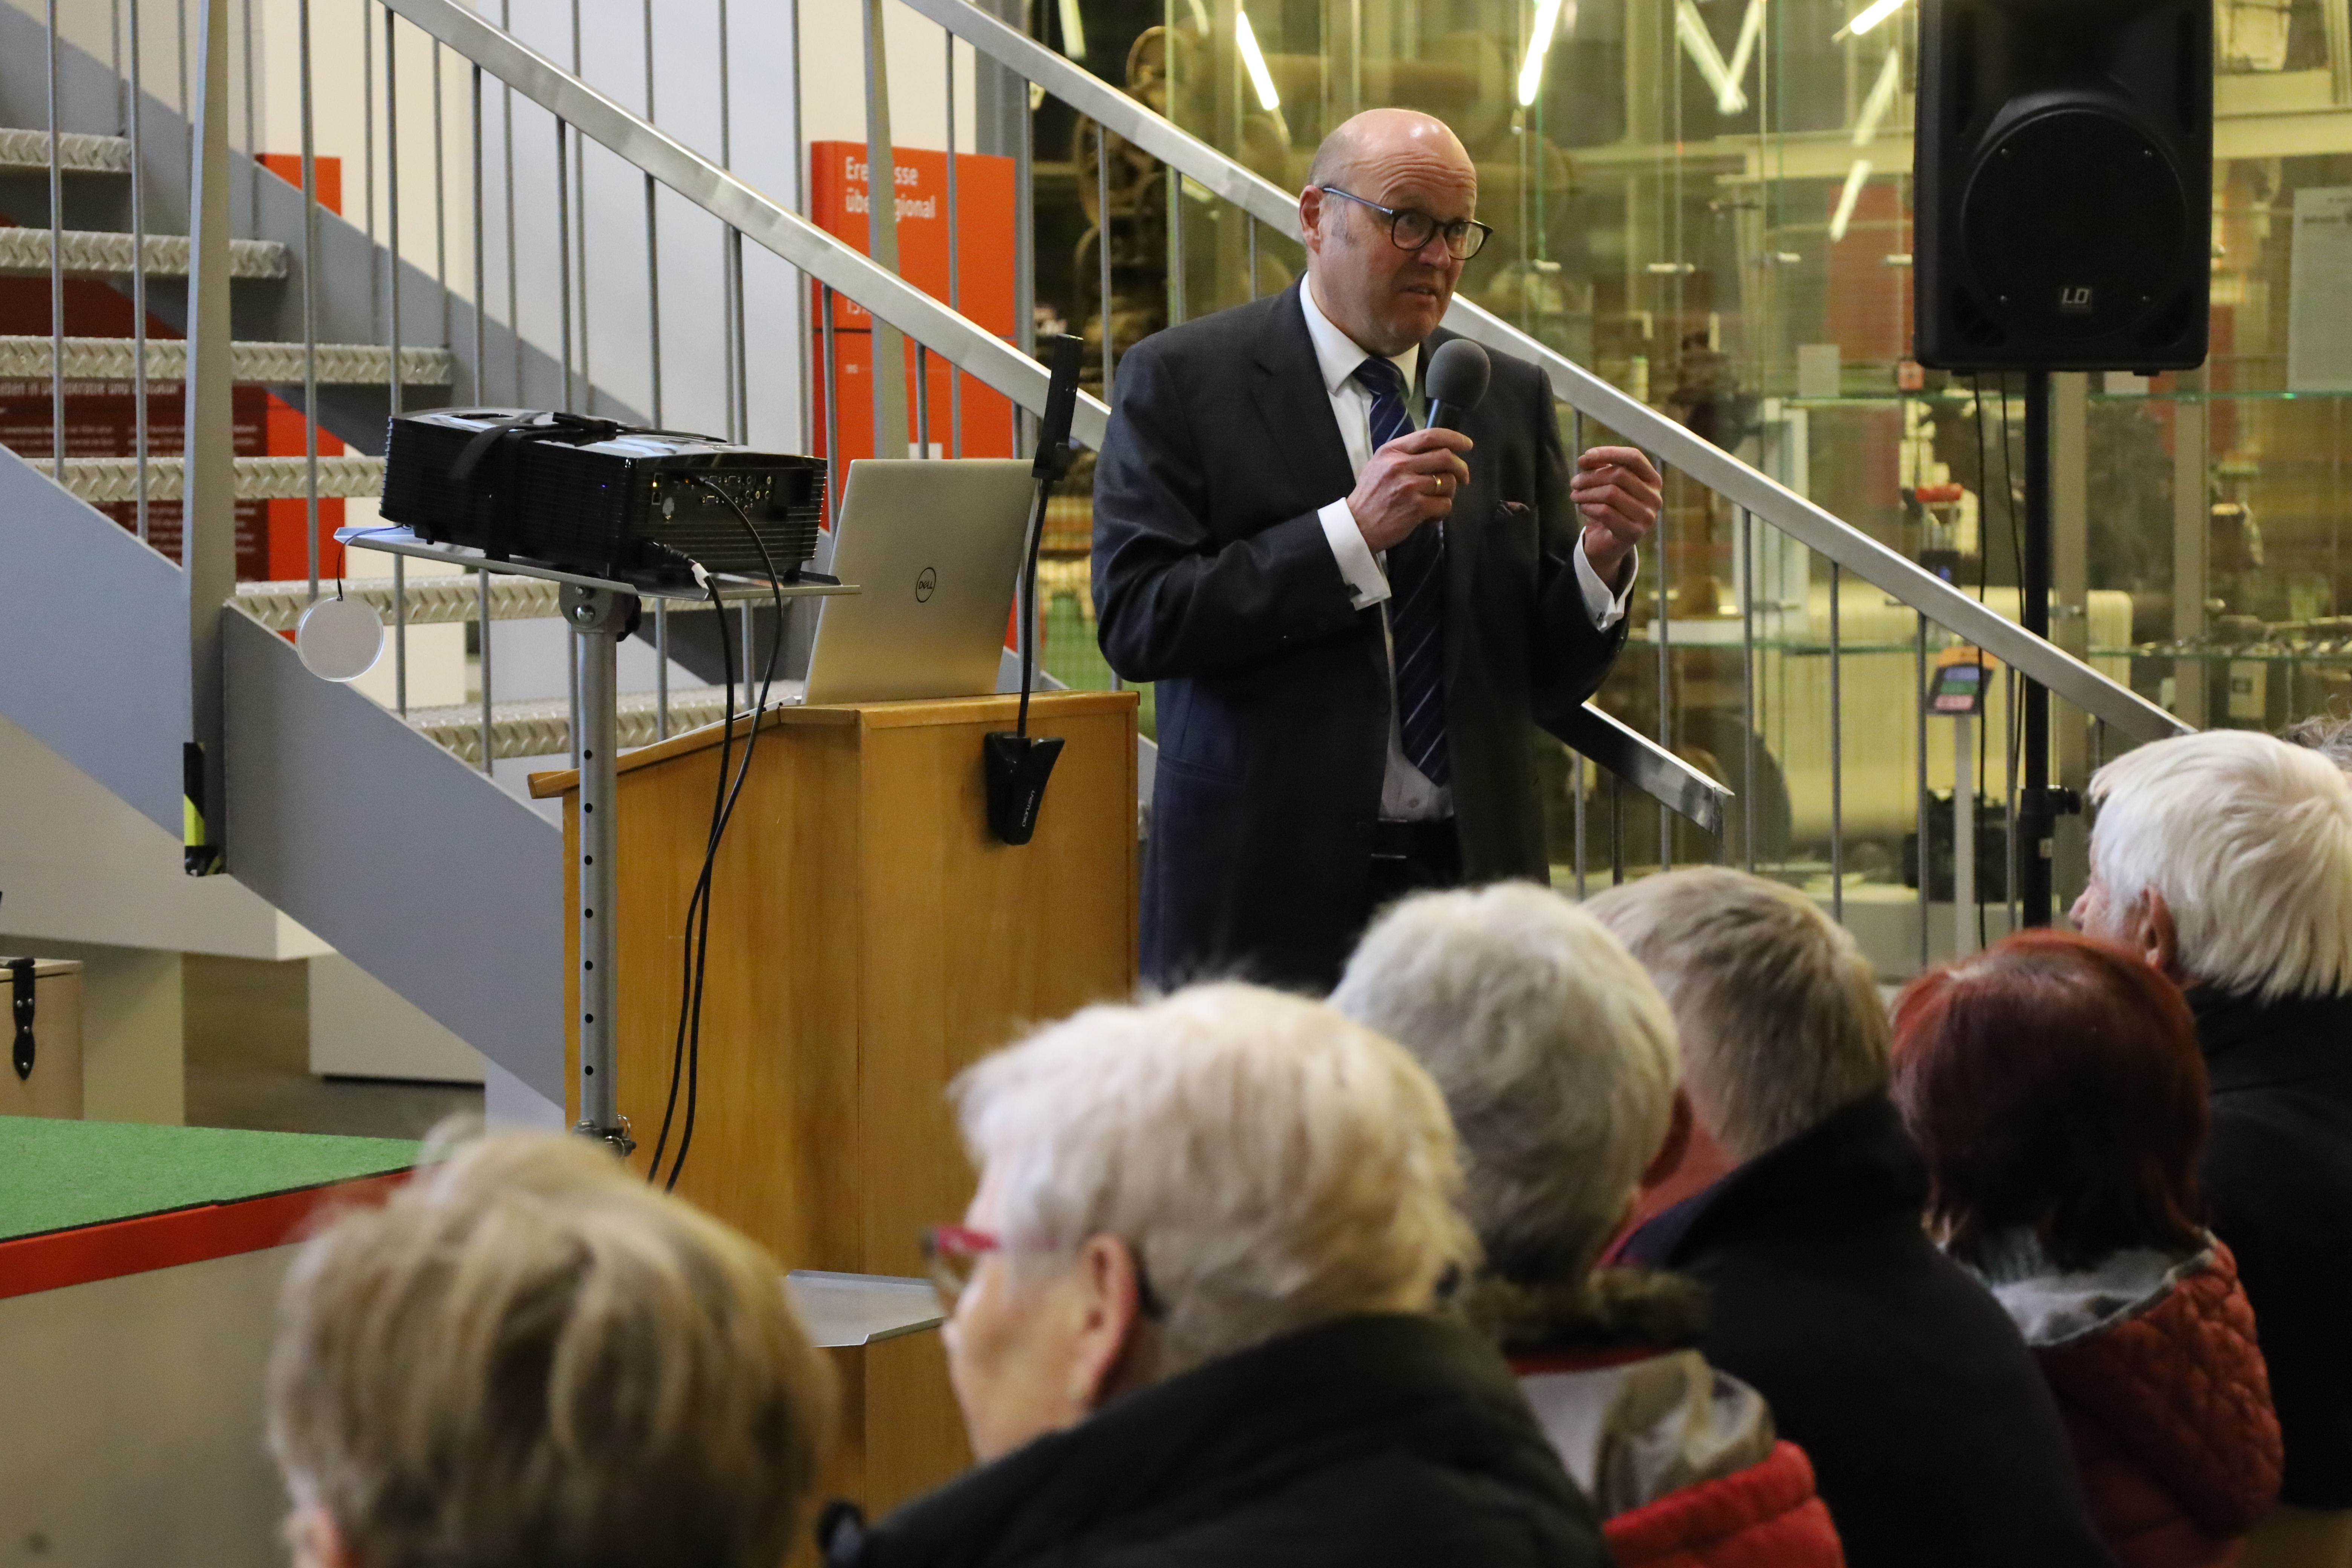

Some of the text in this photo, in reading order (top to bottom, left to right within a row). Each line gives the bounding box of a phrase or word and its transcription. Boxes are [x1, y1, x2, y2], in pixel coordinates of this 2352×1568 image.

[845, 156, 918, 186] Eresse
[845, 187, 936, 222] übegional
[2062, 288, 2090, 304] LD
[919, 581, 933, 589] DELL
